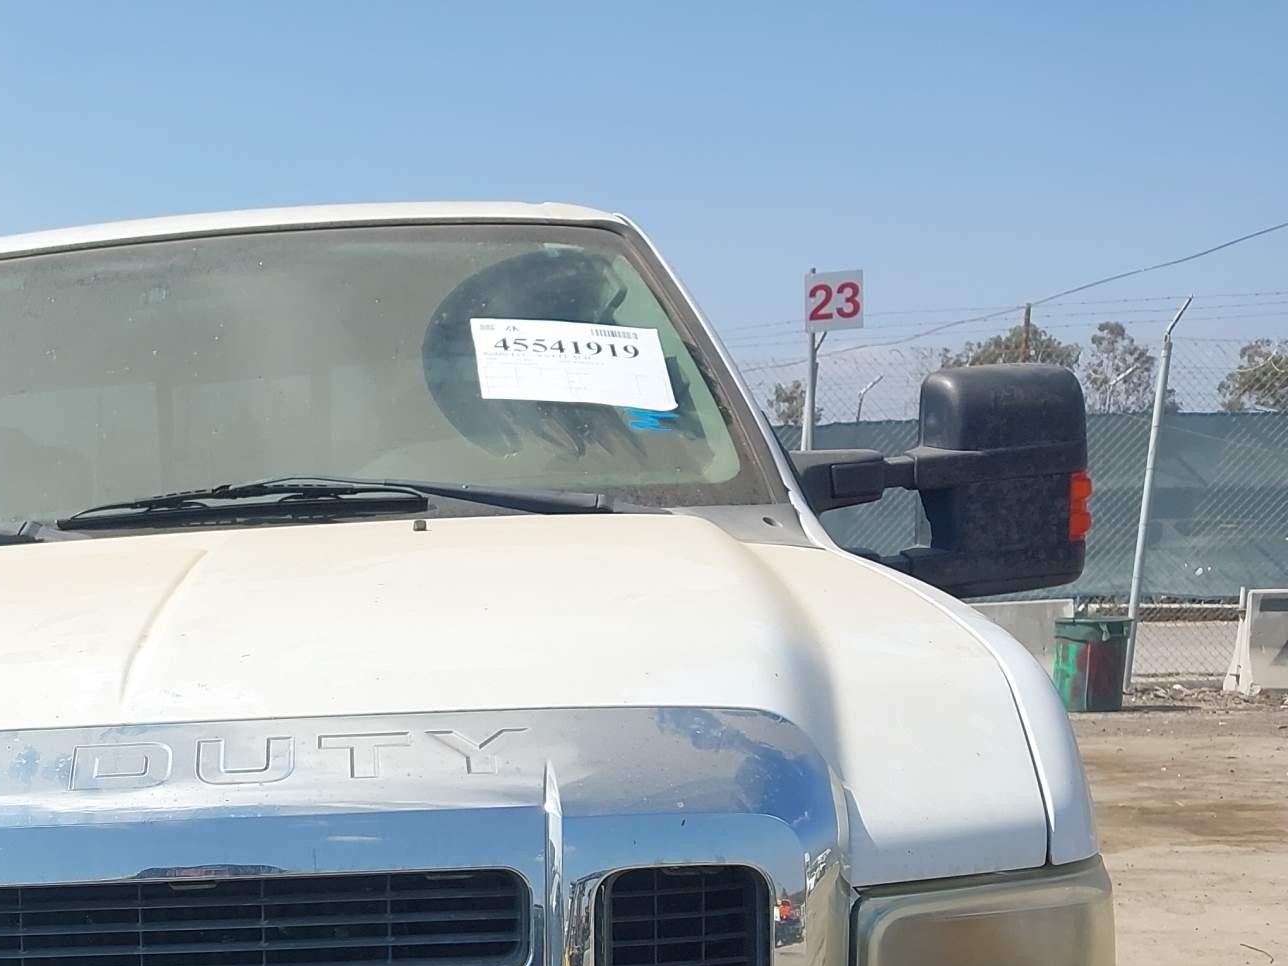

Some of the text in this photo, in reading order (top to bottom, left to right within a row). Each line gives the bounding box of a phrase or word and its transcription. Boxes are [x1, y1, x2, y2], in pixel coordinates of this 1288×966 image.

[809, 282, 860, 321] 23
[494, 337, 640, 359] 45541919
[66, 727, 530, 792] DUTY
